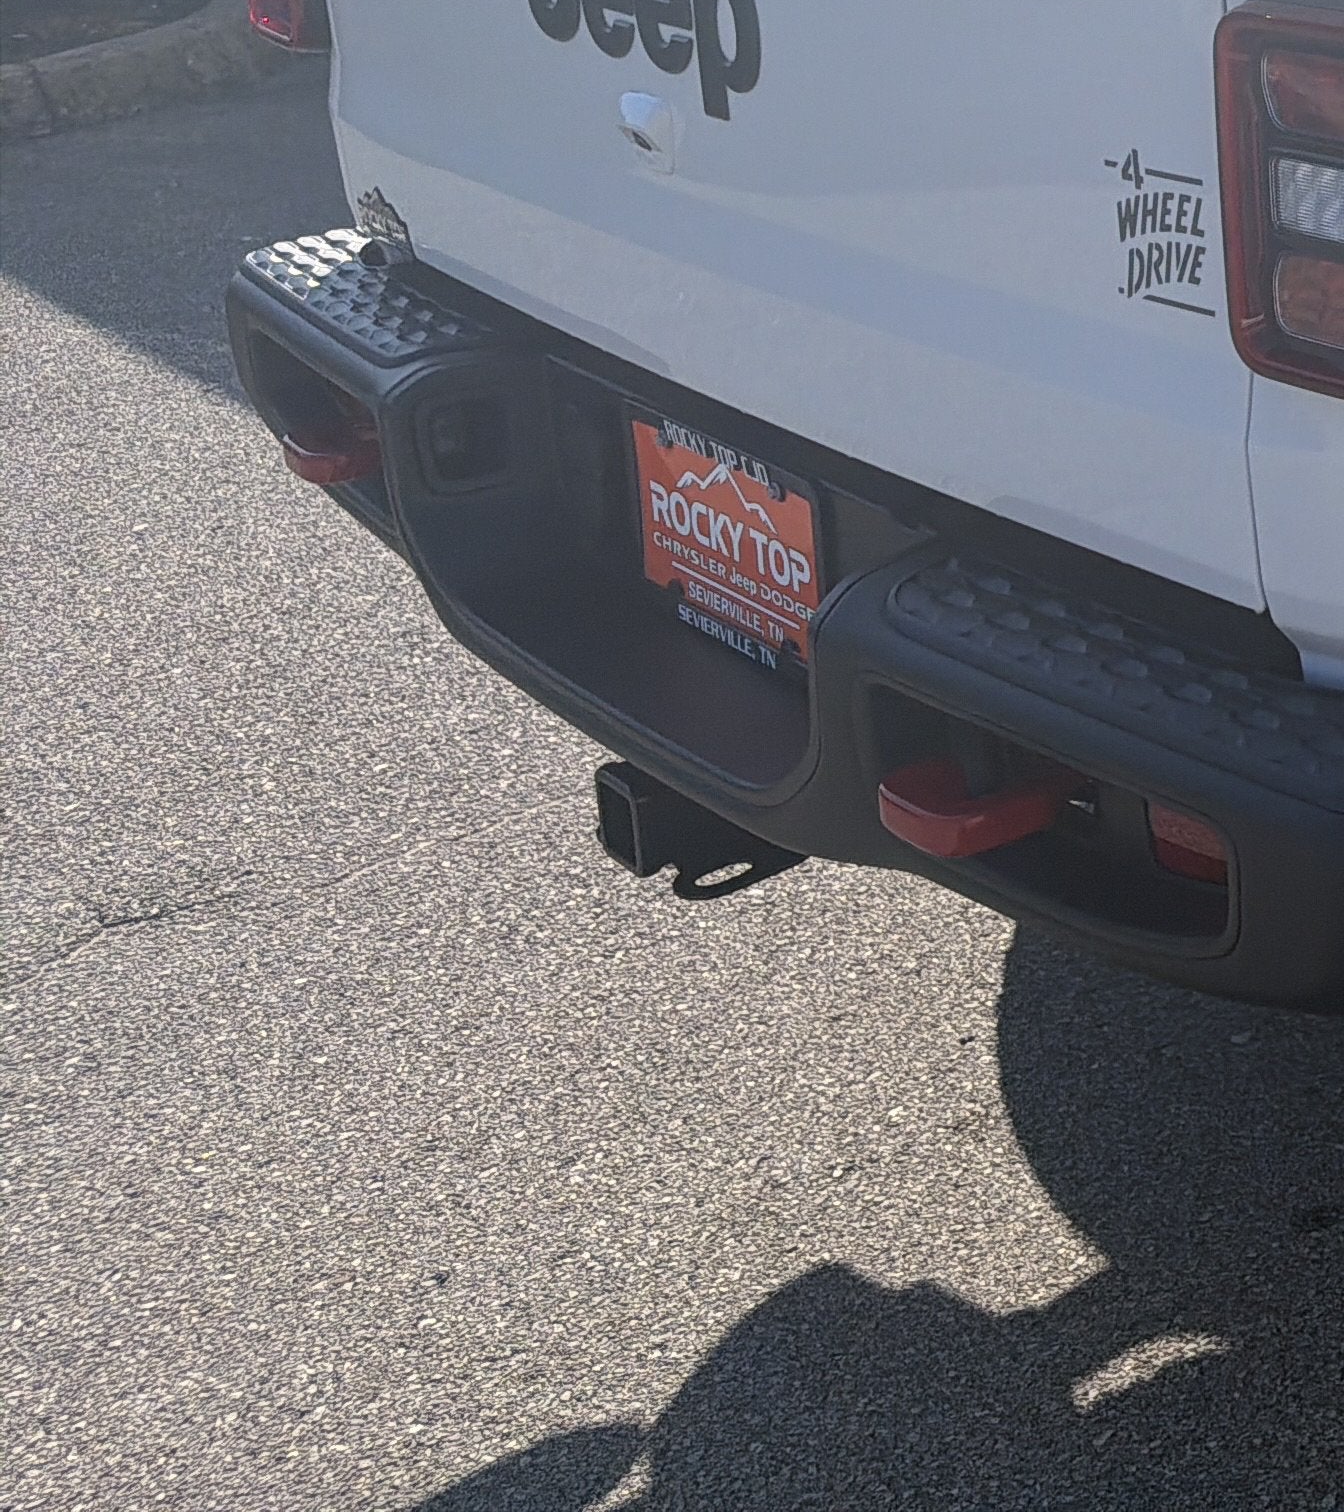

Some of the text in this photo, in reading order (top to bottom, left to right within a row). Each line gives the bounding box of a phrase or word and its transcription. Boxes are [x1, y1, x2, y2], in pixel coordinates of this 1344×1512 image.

[1121, 148, 1144, 190] 4
[1116, 191, 1205, 243] WHEEL
[1127, 240, 1207, 298] DRIVE
[664, 420, 708, 455] ROCKY
[709, 440, 737, 473] TOP
[649, 480, 811, 593] ROCKY TOP
[653, 531, 728, 579] CHRYSLER
[729, 566, 757, 597] Jeep
[677, 604, 777, 670] SEVIERVILLE, TN
[687, 581, 784, 643] SEVIERVILLE, TN
